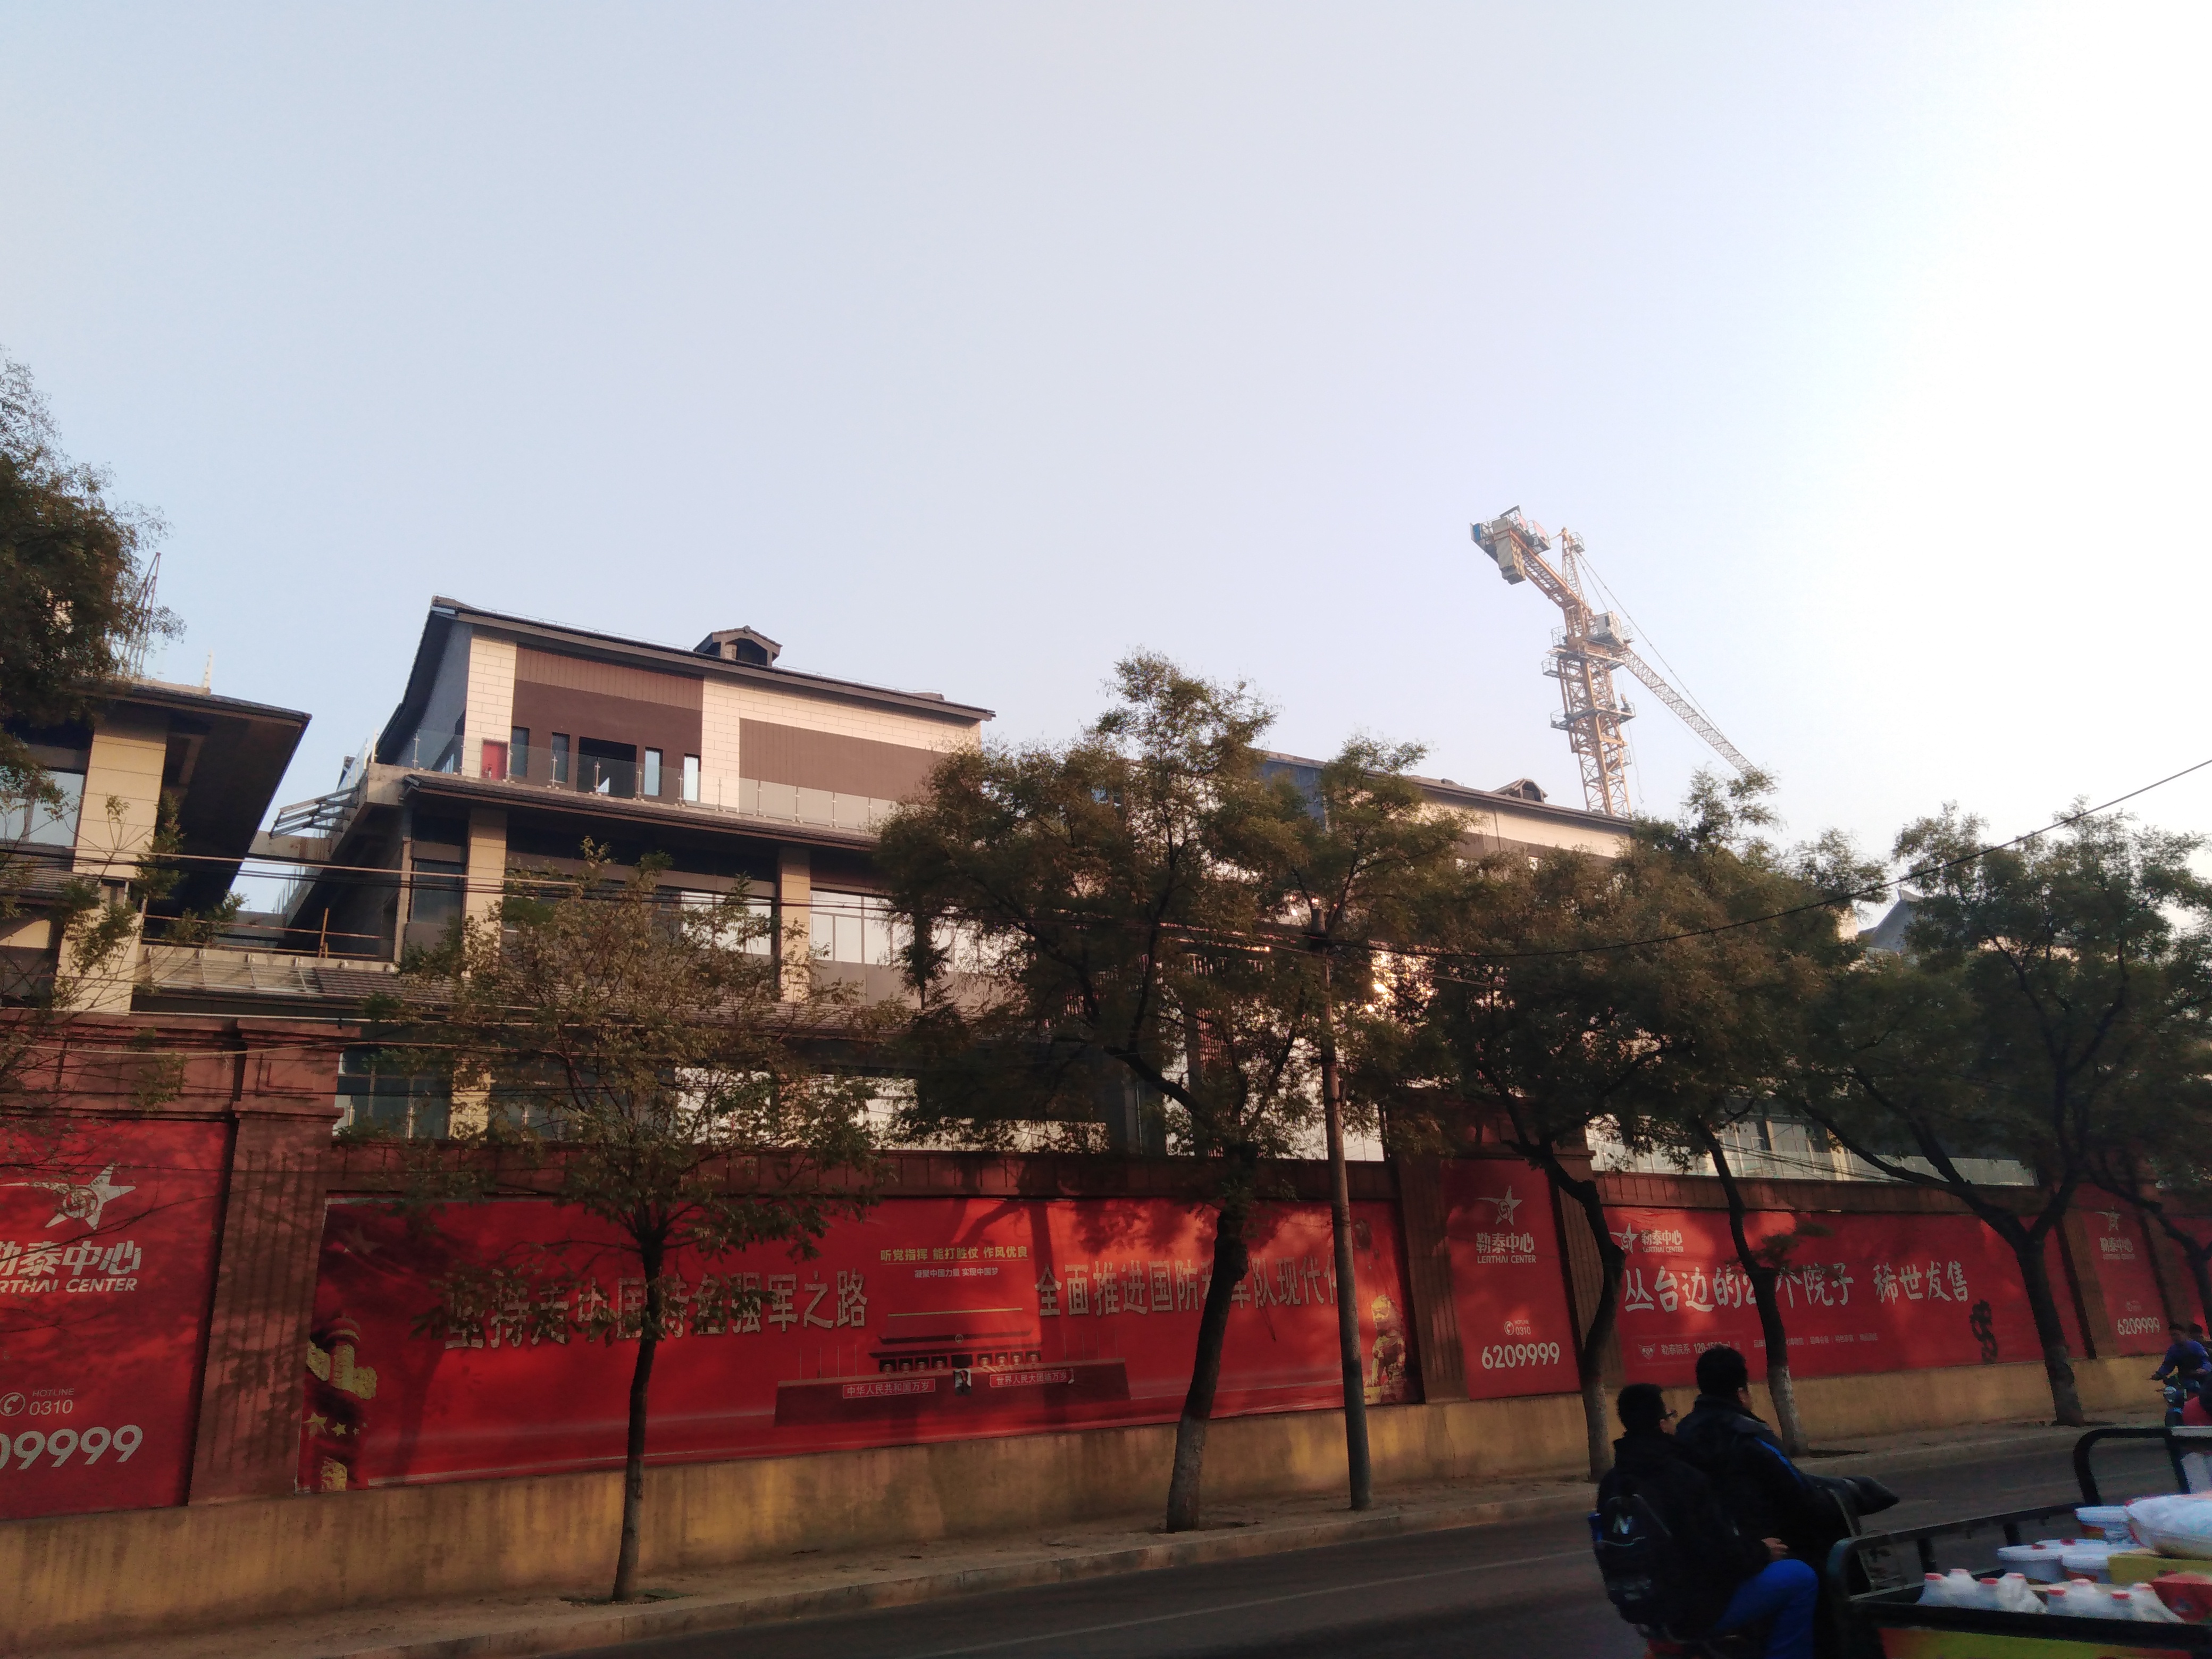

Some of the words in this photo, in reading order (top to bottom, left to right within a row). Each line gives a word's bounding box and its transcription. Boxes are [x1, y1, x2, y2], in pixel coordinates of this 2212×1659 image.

[1476, 1232, 1535, 1254] 勒泰中心
[1641, 1229, 1683, 1245] 勒泰中心
[880, 1248, 928, 1261] 听党指挥
[933, 1247, 978, 1260] 能打胜仗
[983, 1245, 1028, 1259] 作风优良
[1477, 1255, 1509, 1264] LERTHAI
[1511, 1254, 1537, 1264] CENTER
[65, 1277, 138, 1293] CENTER
[1872, 1260, 1968, 1305] 稀世发售
[1515, 1326, 1531, 1336] 0310
[2117, 1316, 2160, 1335] 6209999
[1481, 1342, 1560, 1370] 6209999
[996, 1371, 1067, 1385] 世界人民大团结万岁
[32, 1388, 75, 1398] HOTLINE
[847, 1381, 929, 1396] 中华人民共和国万岁
[29, 1398, 73, 1416] 0310
